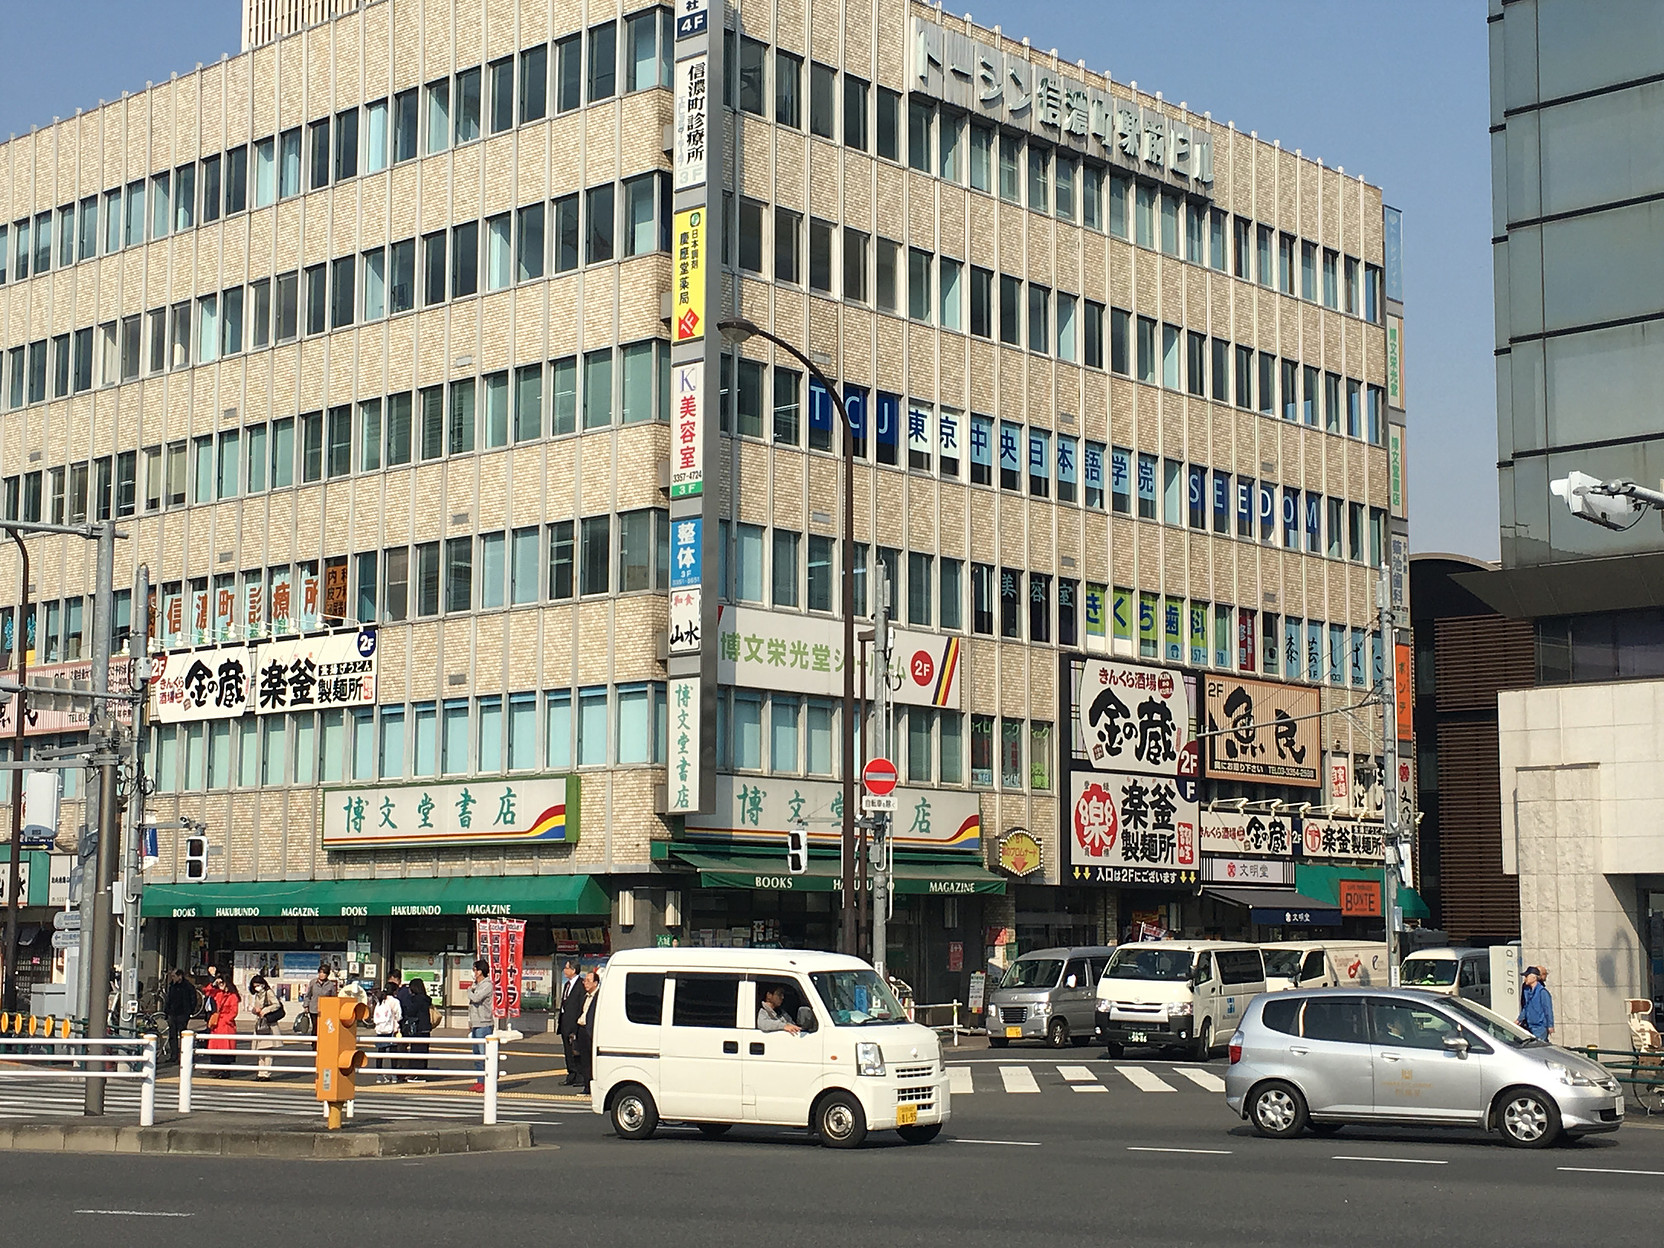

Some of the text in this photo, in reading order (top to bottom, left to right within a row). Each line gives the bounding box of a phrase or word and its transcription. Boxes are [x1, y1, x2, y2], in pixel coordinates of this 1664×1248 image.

[681, 15, 704, 31] 4F
[686, 61, 706, 165] 信濃町診療所
[679, 231, 690, 306] 慶應堂薬局
[681, 311, 698, 334] 1F
[680, 368, 696, 393] K
[680, 394, 697, 470] 美容室
[810, 384, 1318, 530] TCJ 東京中央日本語学院 SEEDOM
[672, 469, 702, 483] 3357-4724
[679, 482, 695, 495] 3F
[677, 521, 696, 569] 整体
[674, 593, 695, 608] 和食
[1000, 573, 1074, 608] 美容室
[1086, 592, 1206, 641] きくち歯科
[359, 634, 375, 651] 2F
[670, 619, 701, 646] 山水
[152, 658, 165, 678] 2F
[320, 660, 372, 677] 釜揚げうどん
[914, 659, 931, 677] 2F
[1098, 667, 1157, 691] きんくら酒場
[160, 676, 185, 690] きんくら
[185, 658, 246, 708] 金の蔵
[260, 657, 317, 709] 楽釜
[318, 676, 363, 704] 製麺所
[1208, 682, 1223, 697] 2F
[1088, 687, 1177, 766] 金の蔵
[1224, 686, 1306, 766] 魚民
[674, 683, 693, 810] 博文堂書店
[1181, 750, 1198, 774] 2F
[343, 786, 518, 834] 博文堂書店
[736, 783, 931, 834] 博文堂店
[1121, 779, 1178, 831] 楽釜
[1121, 828, 1176, 865] 製麺所
[1246, 816, 1288, 854] 金の蔵
[1322, 824, 1351, 854] 楽釜
[1351, 833, 1383, 857] 製麺所
[755, 876, 793, 890] BOOKS
[1096, 867, 1177, 884] 入口は2Fにございます
[1239, 863, 1269, 878] 文明堂
[929, 881, 975, 893] MAGAZINE
[172, 904, 511, 918] BOOKS HAKUBUNDO MAGAZINE BOOKS HAKUBUNDO MAGAZINE
[1345, 892, 1376, 912] BONTE
